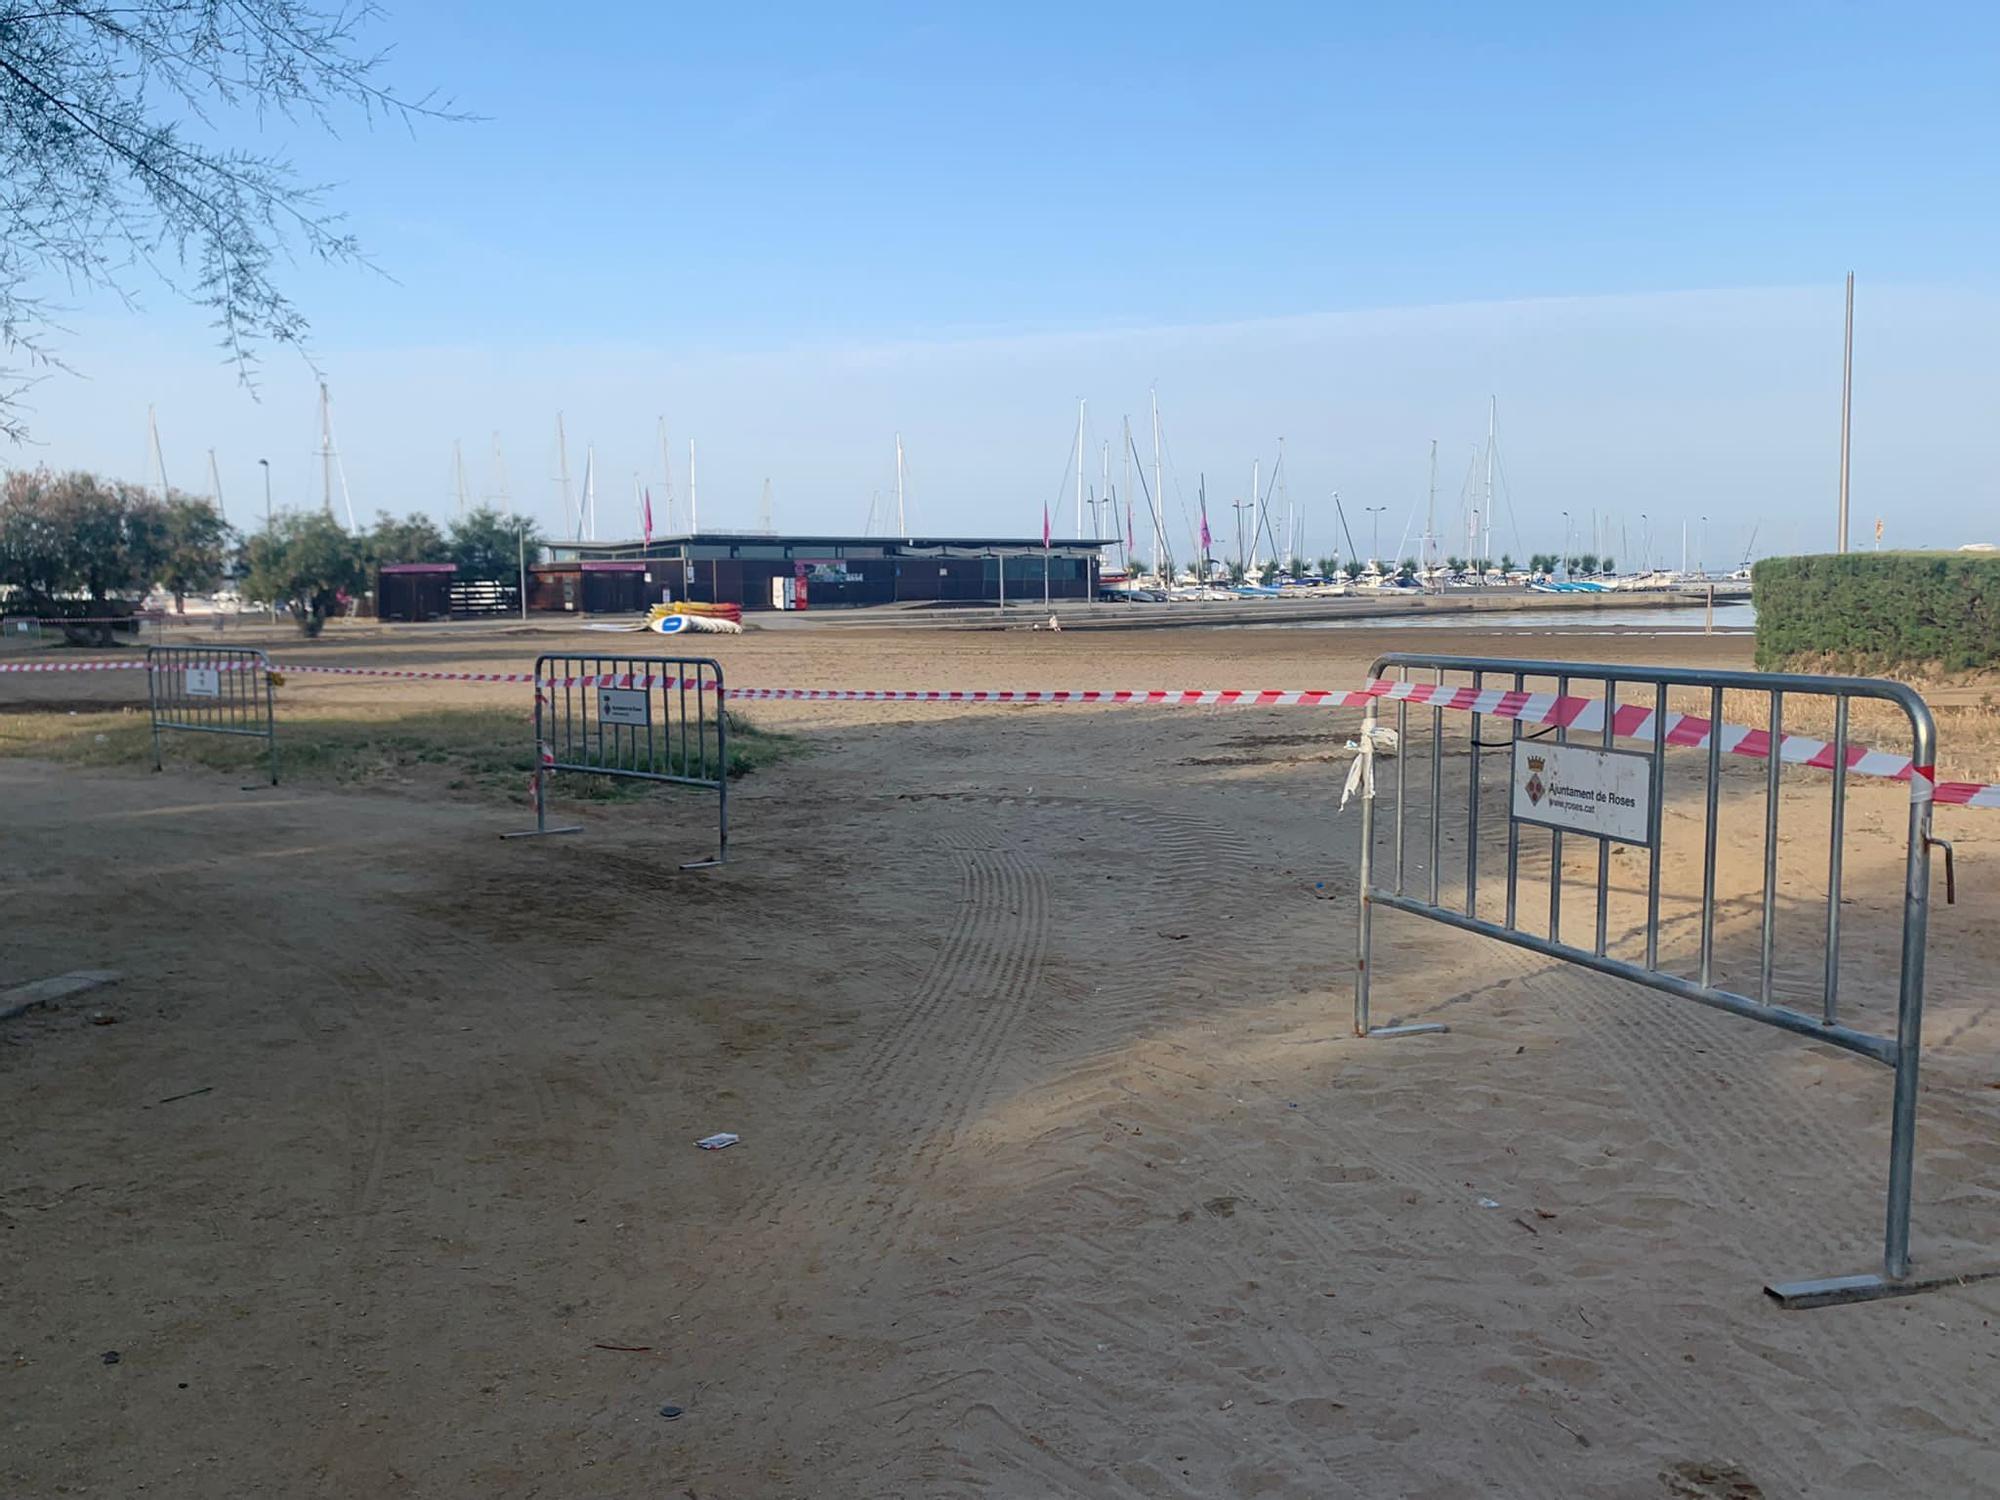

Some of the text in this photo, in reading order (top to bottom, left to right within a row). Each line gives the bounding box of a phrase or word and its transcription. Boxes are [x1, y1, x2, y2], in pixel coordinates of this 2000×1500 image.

[1549, 783, 1636, 808] Ajuntament de Roses
